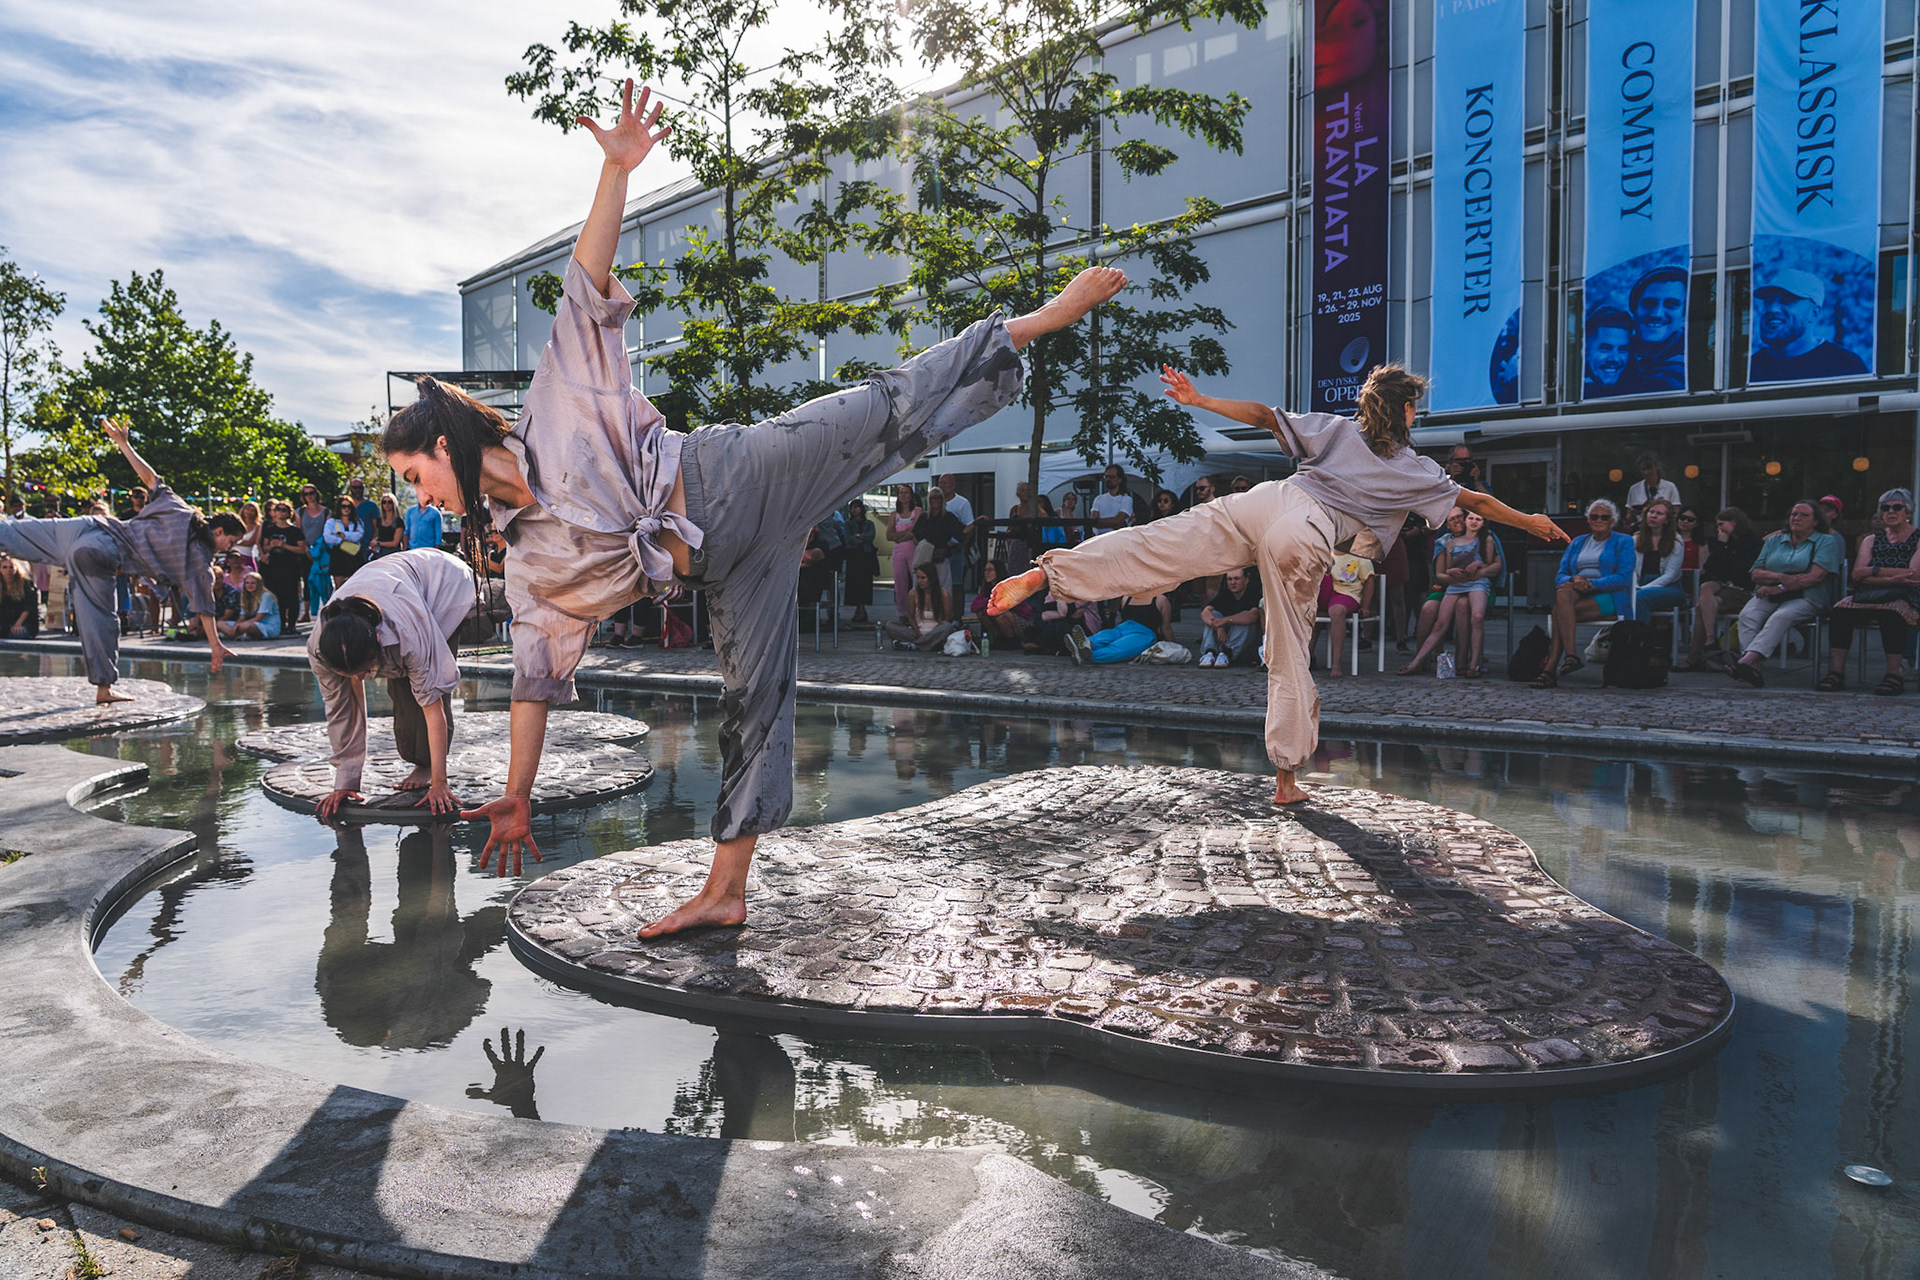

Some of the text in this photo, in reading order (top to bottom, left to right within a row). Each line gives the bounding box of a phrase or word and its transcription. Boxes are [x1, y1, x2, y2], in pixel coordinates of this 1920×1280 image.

[1354, 102, 1379, 187] Verdi LA
[1621, 41, 1656, 221] COMEDY
[1795, 0, 1838, 216] KLASSISK
[1324, 91, 1350, 273] TRAVIATA
[1464, 82, 1494, 319] KONCERTER
[1317, 284, 1383, 303] 19., 21., 23. AUG
[1325, 304, 1339, 314] 26.
[1346, 300, 1360, 310] 29.
[1361, 296, 1383, 308] NOV
[1337, 312, 1361, 324] 2025
[1317, 376, 1359, 388] DEN JYSKE
